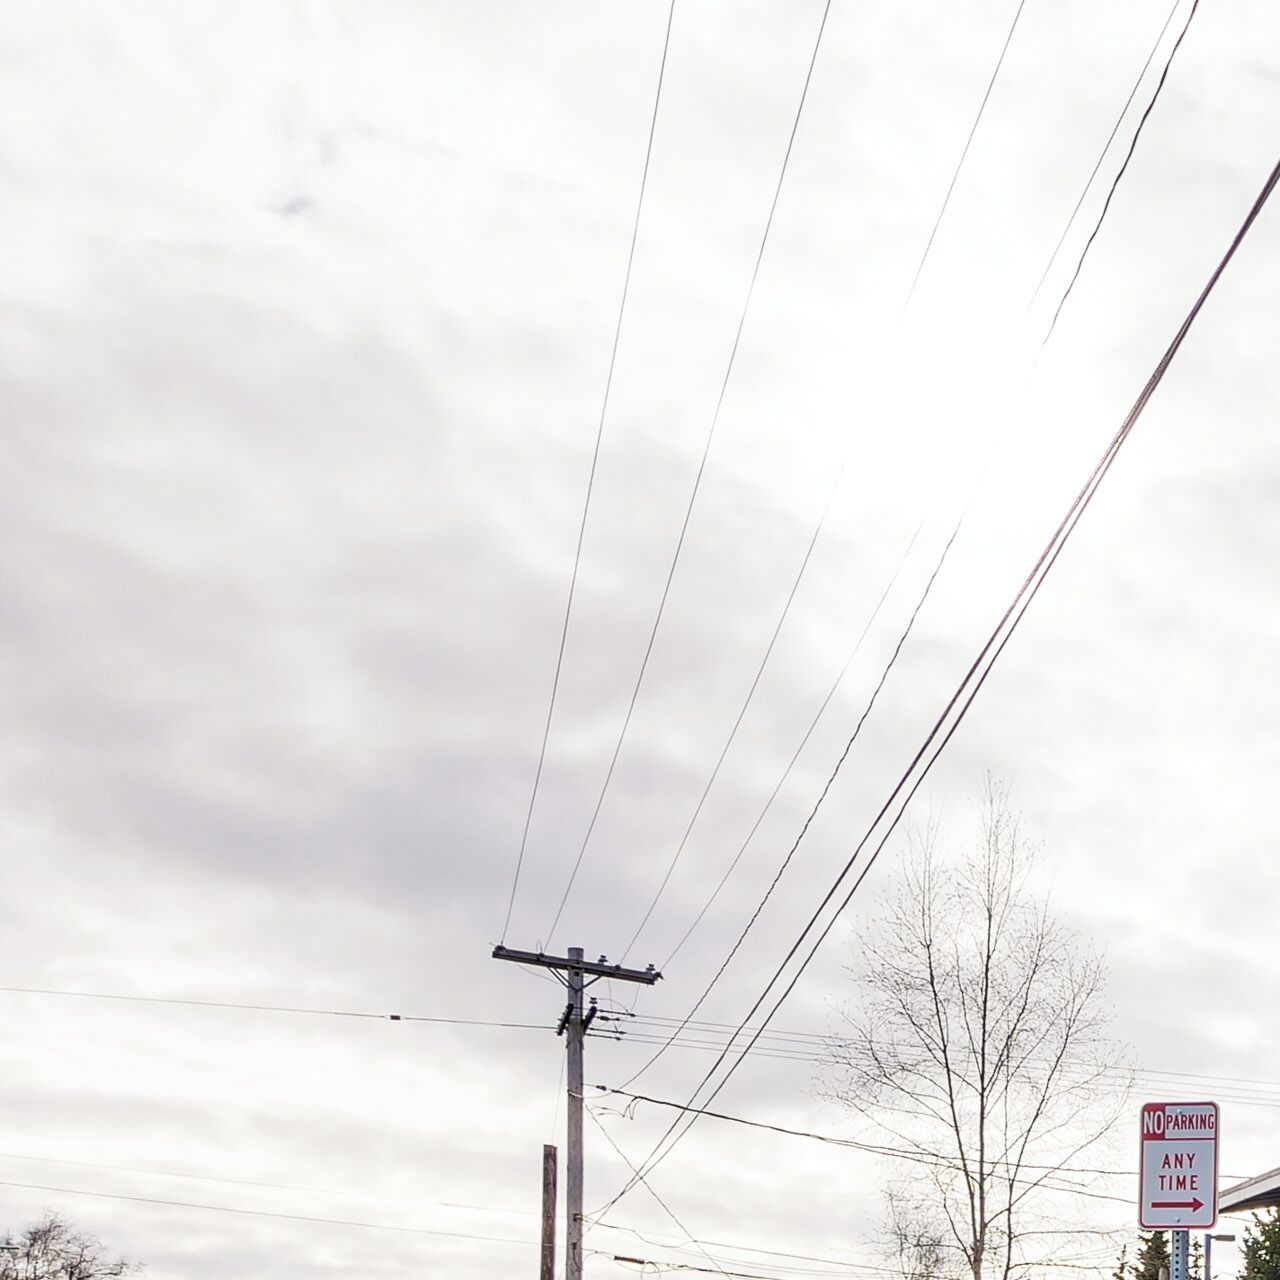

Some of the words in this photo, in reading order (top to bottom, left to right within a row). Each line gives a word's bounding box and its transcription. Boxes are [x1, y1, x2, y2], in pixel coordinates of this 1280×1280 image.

[1143, 1111, 1164, 1134] NO
[1166, 1114, 1214, 1130] PARKING
[1161, 1153, 1196, 1169] ANY
[1158, 1175, 1198, 1190] TIME
